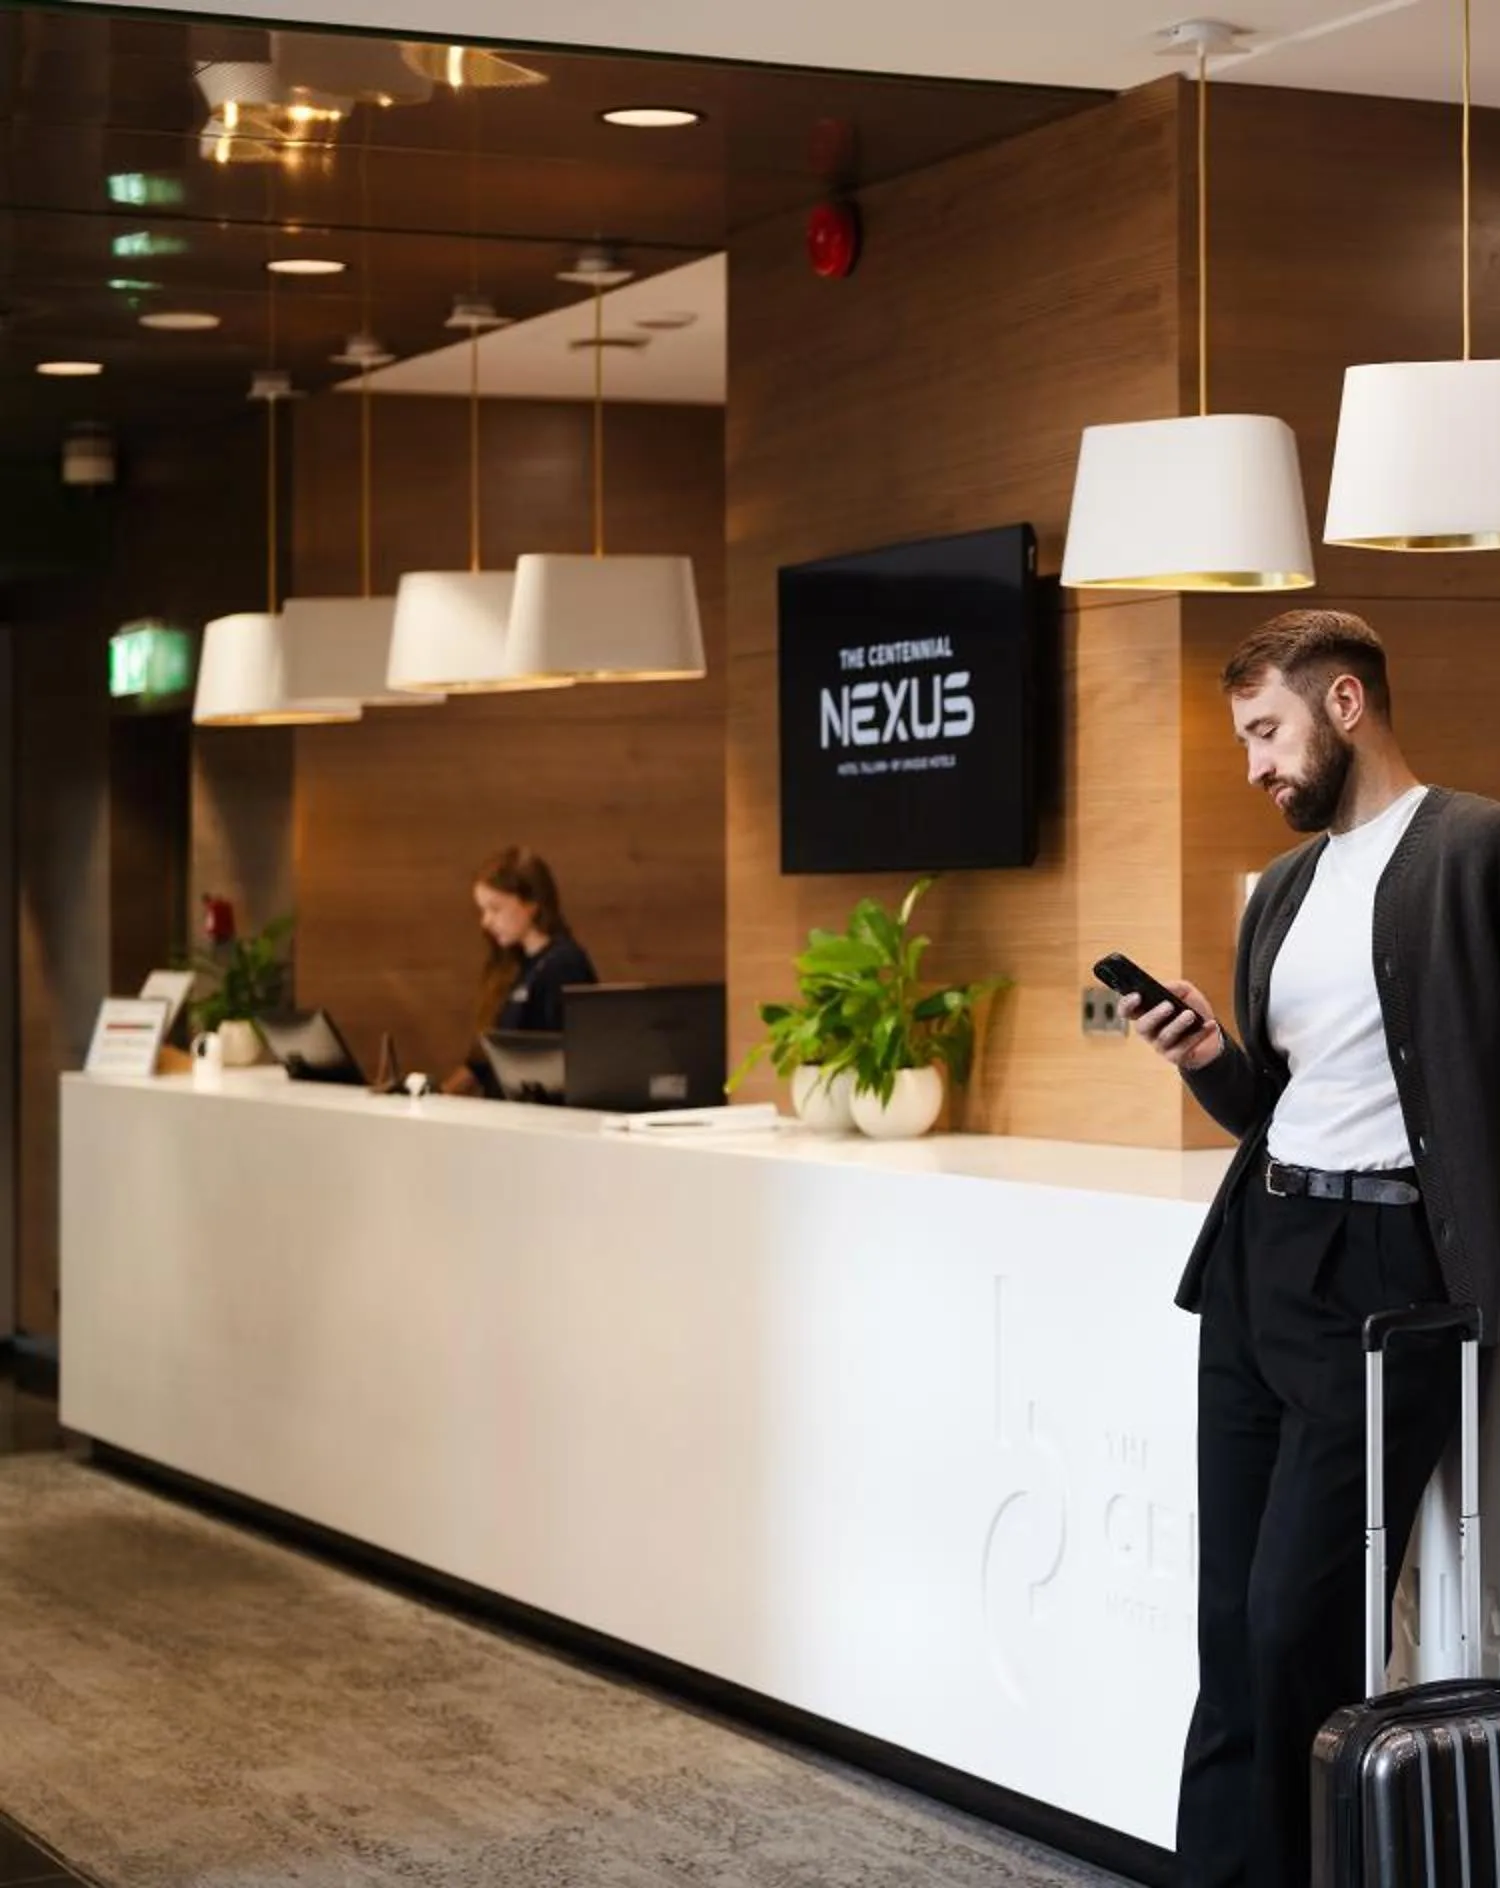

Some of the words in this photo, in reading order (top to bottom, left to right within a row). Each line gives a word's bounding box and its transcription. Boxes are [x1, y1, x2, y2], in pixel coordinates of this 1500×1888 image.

[839, 648, 865, 670] THE
[868, 636, 953, 666] CENTENNIAL
[821, 671, 975, 749] NEXUS
